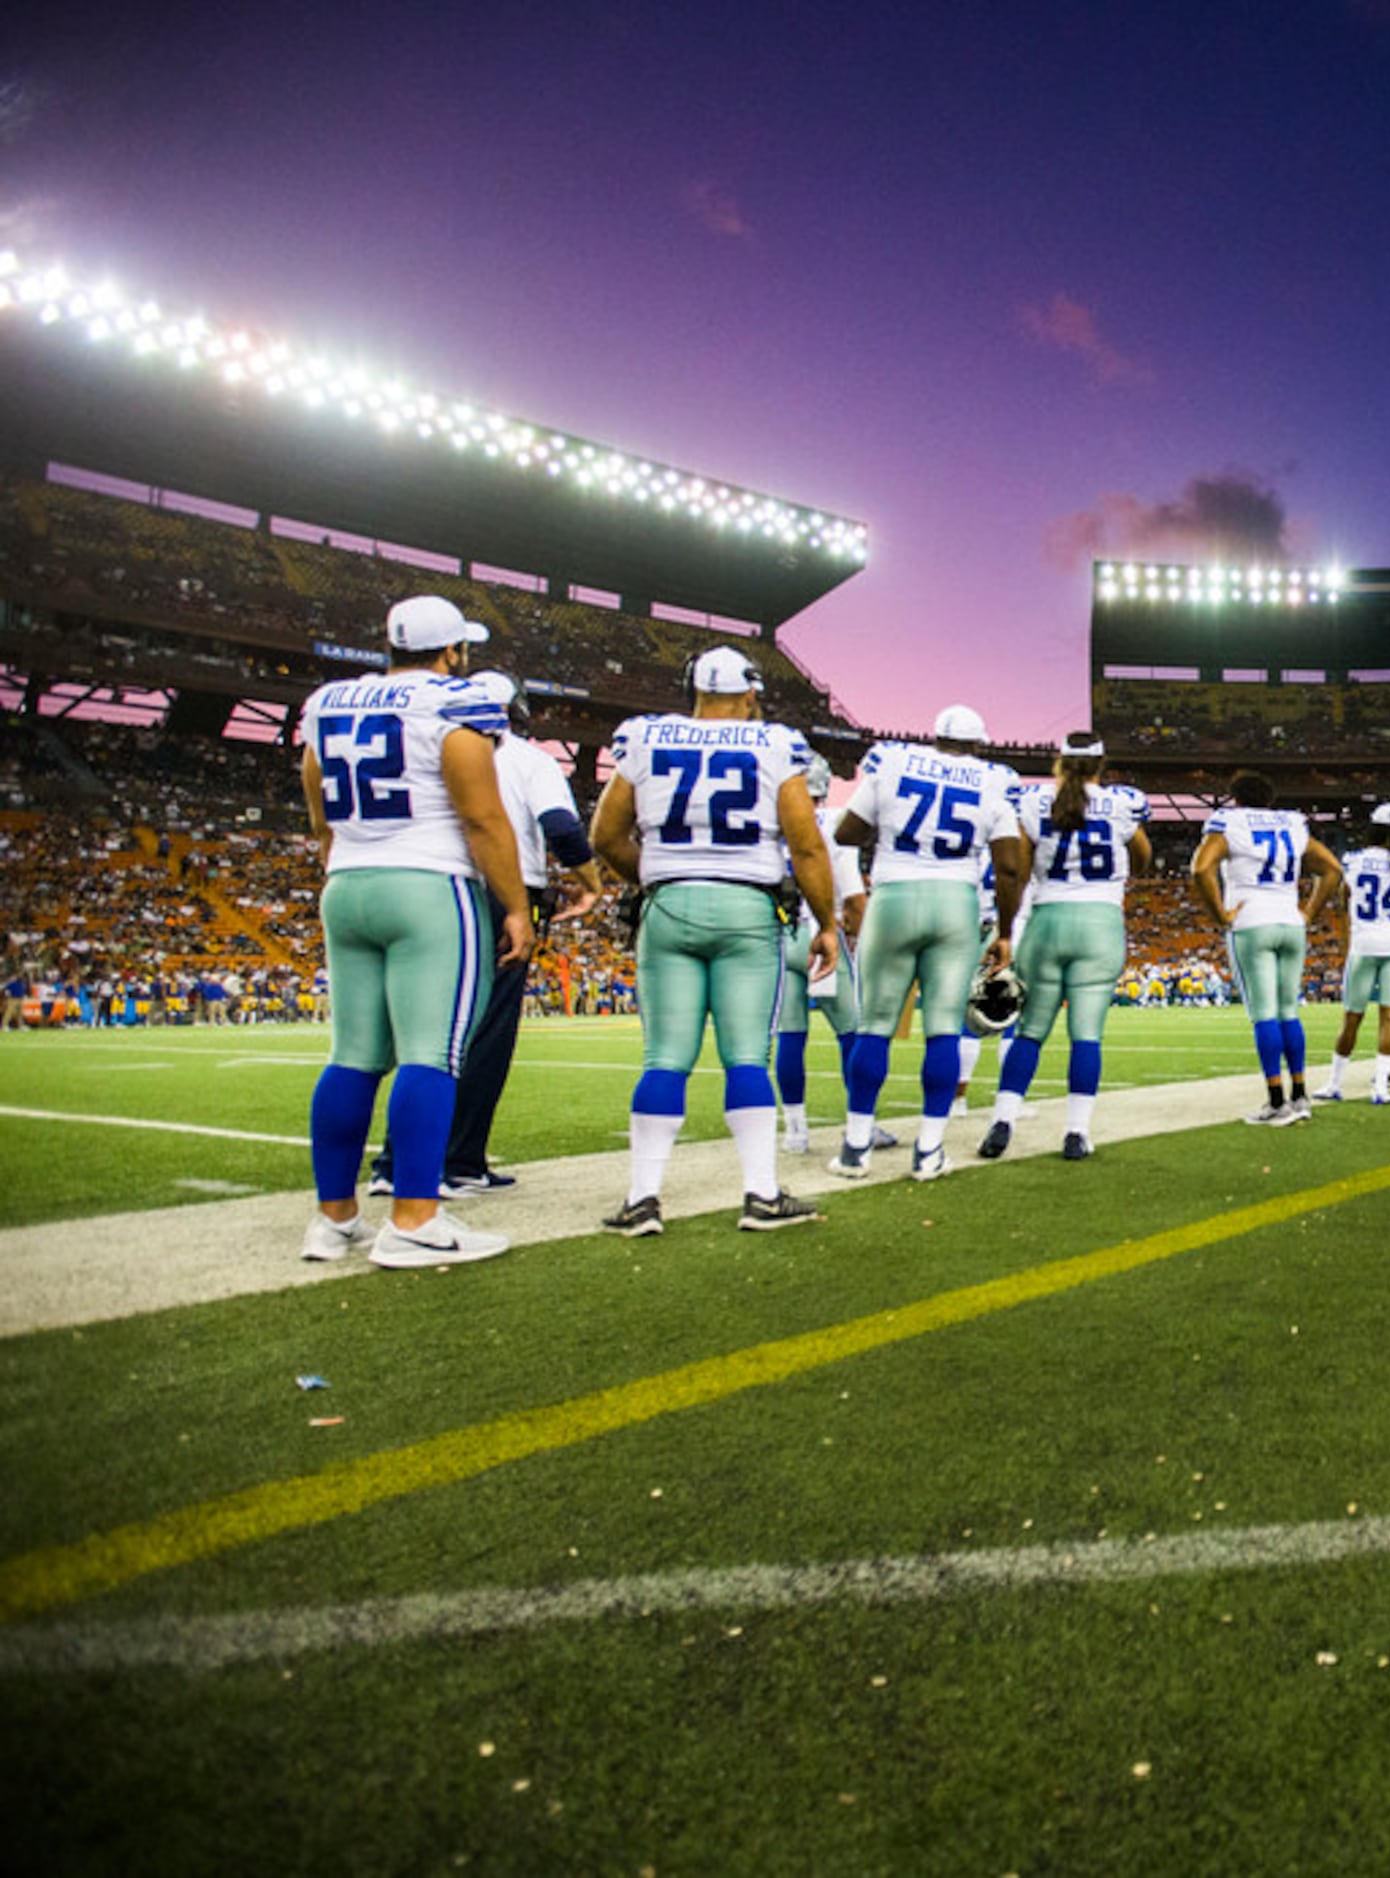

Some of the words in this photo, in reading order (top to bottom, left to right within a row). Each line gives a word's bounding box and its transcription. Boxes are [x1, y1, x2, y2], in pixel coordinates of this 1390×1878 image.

[320, 685, 416, 709] WILLIAMS
[643, 724, 770, 748] FREDERICK
[318, 713, 413, 819] 52
[906, 754, 982, 787] FLEMING
[651, 749, 760, 845] 72
[894, 776, 982, 859] 75
[1040, 818, 1113, 881] 76
[1252, 829, 1294, 882] 71
